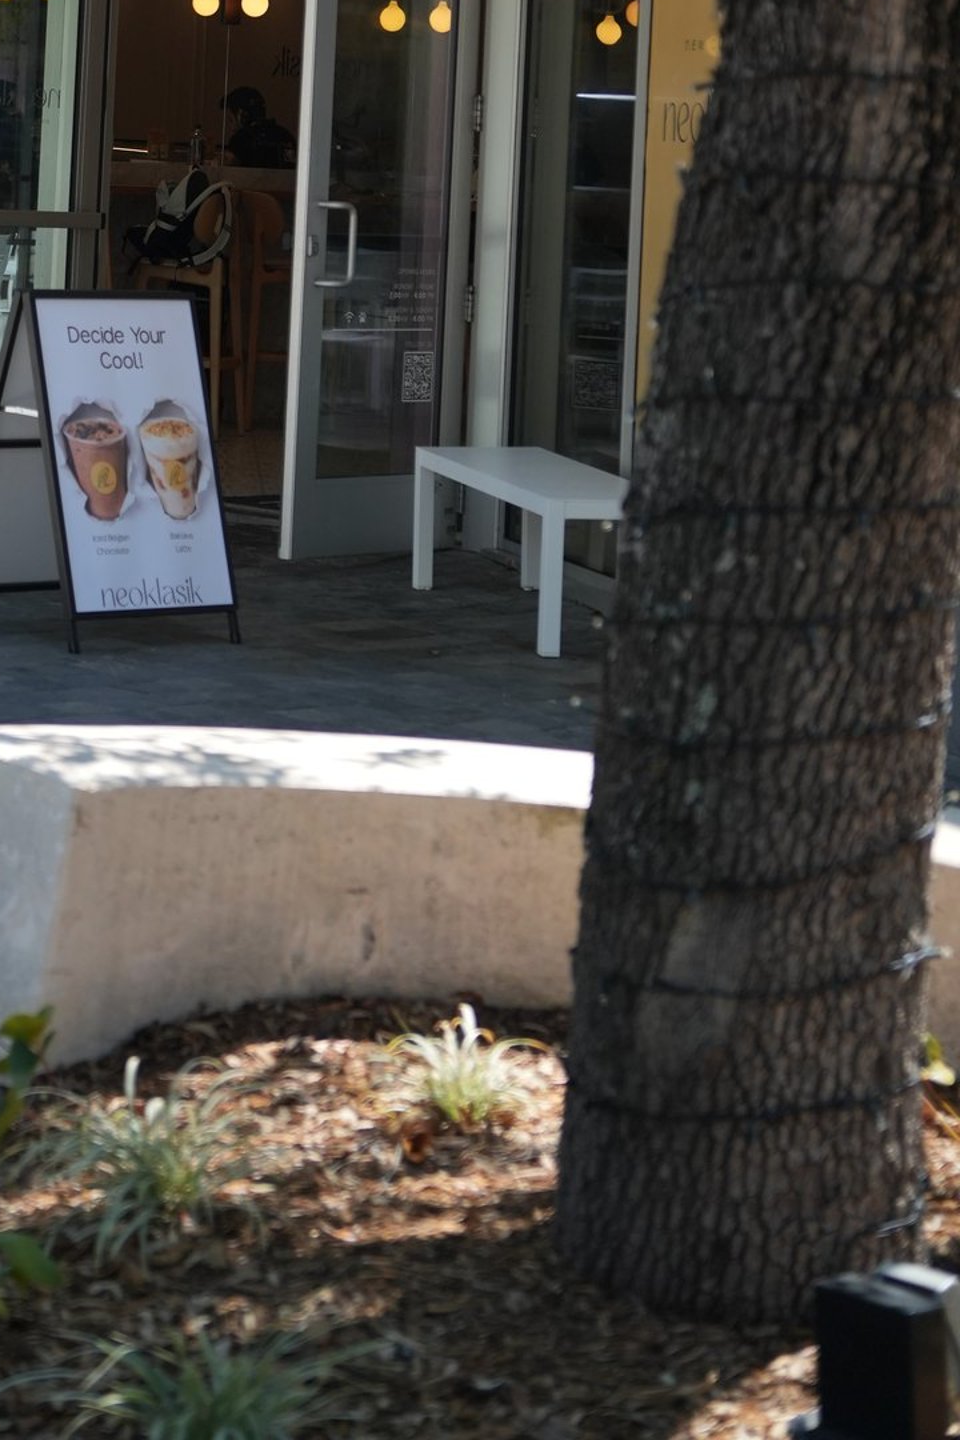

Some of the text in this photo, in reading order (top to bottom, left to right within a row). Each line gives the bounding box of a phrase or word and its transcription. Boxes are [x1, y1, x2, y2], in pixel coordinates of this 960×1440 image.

[67, 326, 165, 344] Decide Your
[100, 351, 143, 369] Cool!
[101, 576, 203, 608] neoklasik
